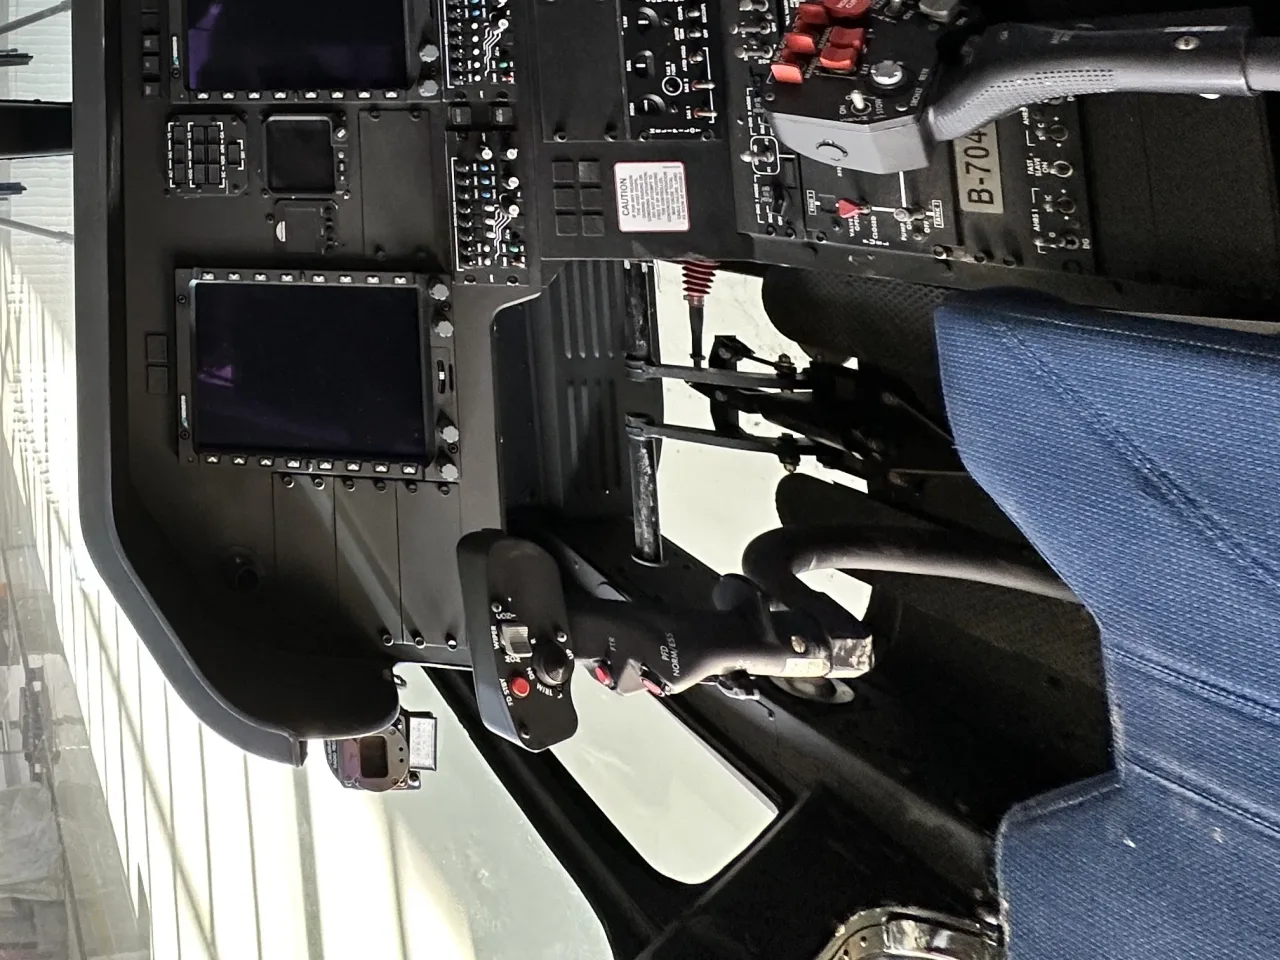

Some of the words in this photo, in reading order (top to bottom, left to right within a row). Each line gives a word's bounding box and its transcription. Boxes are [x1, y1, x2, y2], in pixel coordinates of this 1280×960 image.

[840, 104, 846, 114] ON
[1034, 158, 1042, 176] SLAVE
[1041, 161, 1049, 173] ON
[619, 178, 630, 216] CAUTION
[491, 626, 500, 650] WIPER
[566, 648, 574, 660] UP
[660, 645, 670, 660] PFD
[665, 632, 680, 676] NORM/ESS
[526, 667, 536, 680] DN
[499, 678, 510, 695] STBY
[536, 682, 553, 696] TRIM
[506, 696, 514, 706] FD
